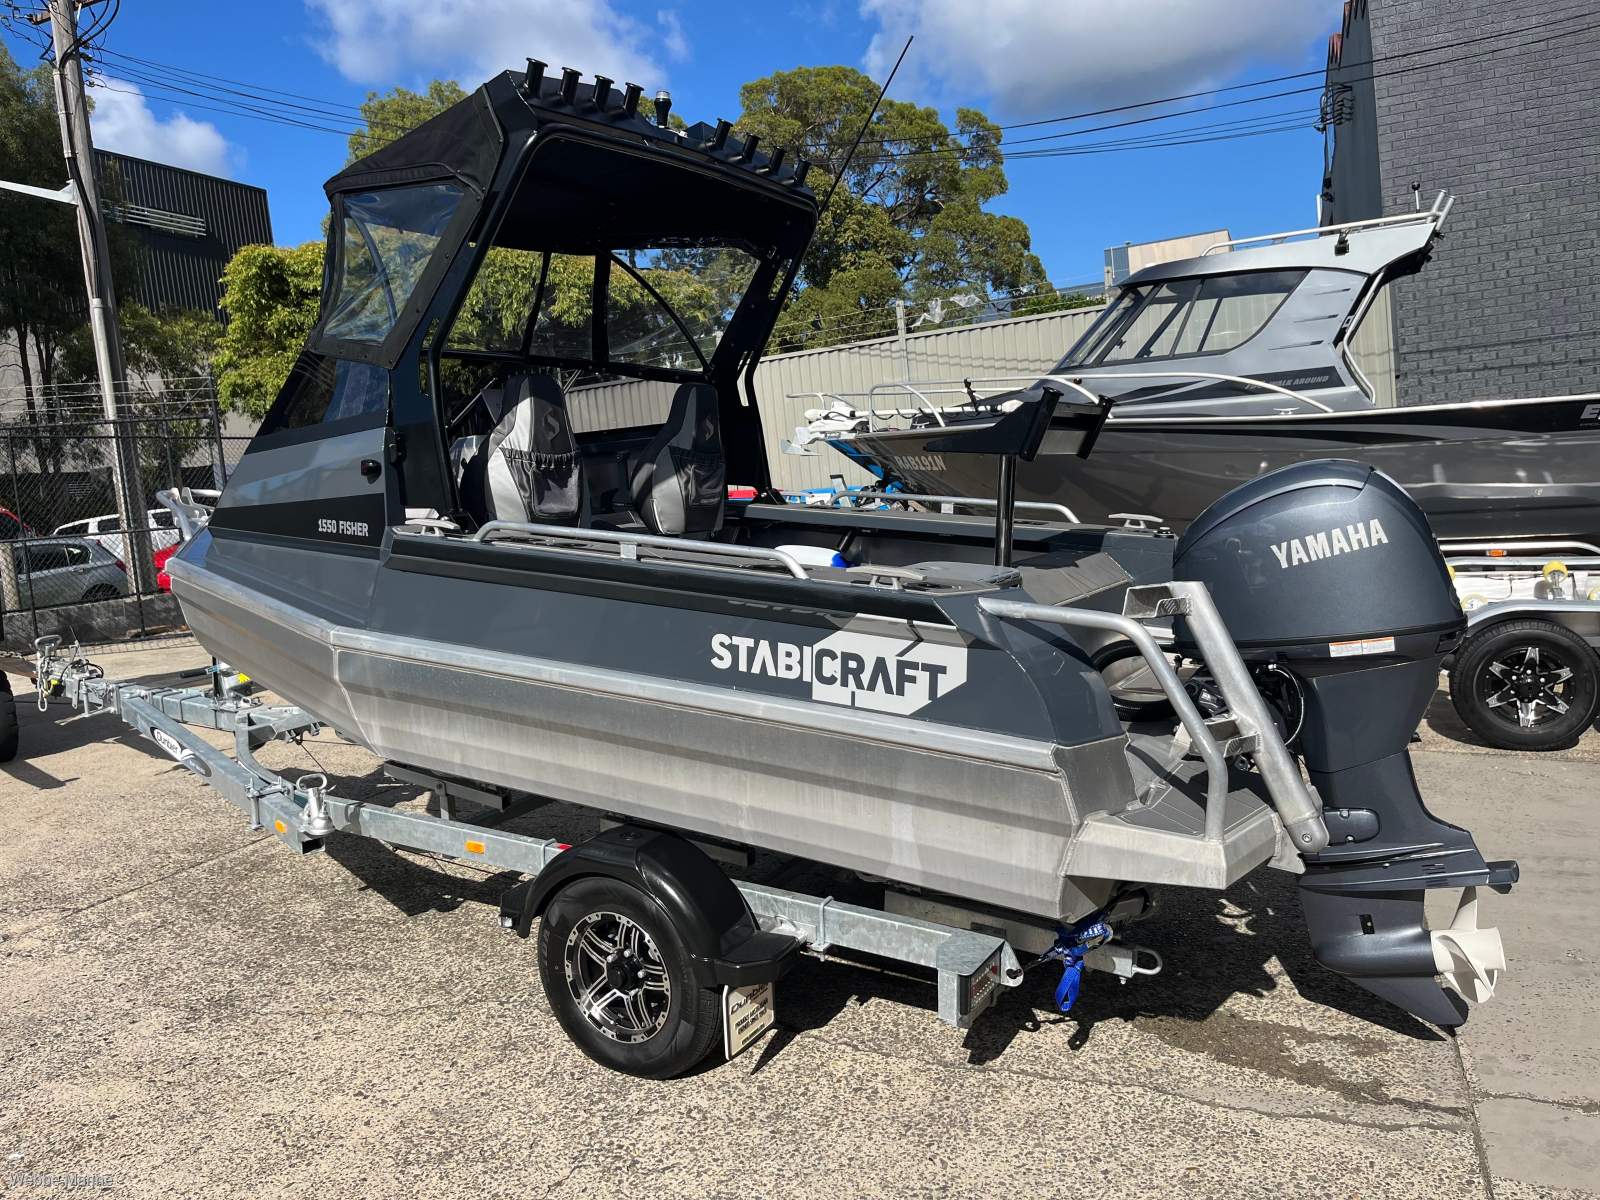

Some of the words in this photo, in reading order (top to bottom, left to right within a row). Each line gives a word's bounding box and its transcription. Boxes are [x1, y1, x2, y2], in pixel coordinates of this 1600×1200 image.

[318, 518, 337, 534] 1550
[339, 520, 369, 537] FISHER
[1270, 518, 1389, 569] YAMAHA
[710, 633, 947, 699] STABICRAFT
